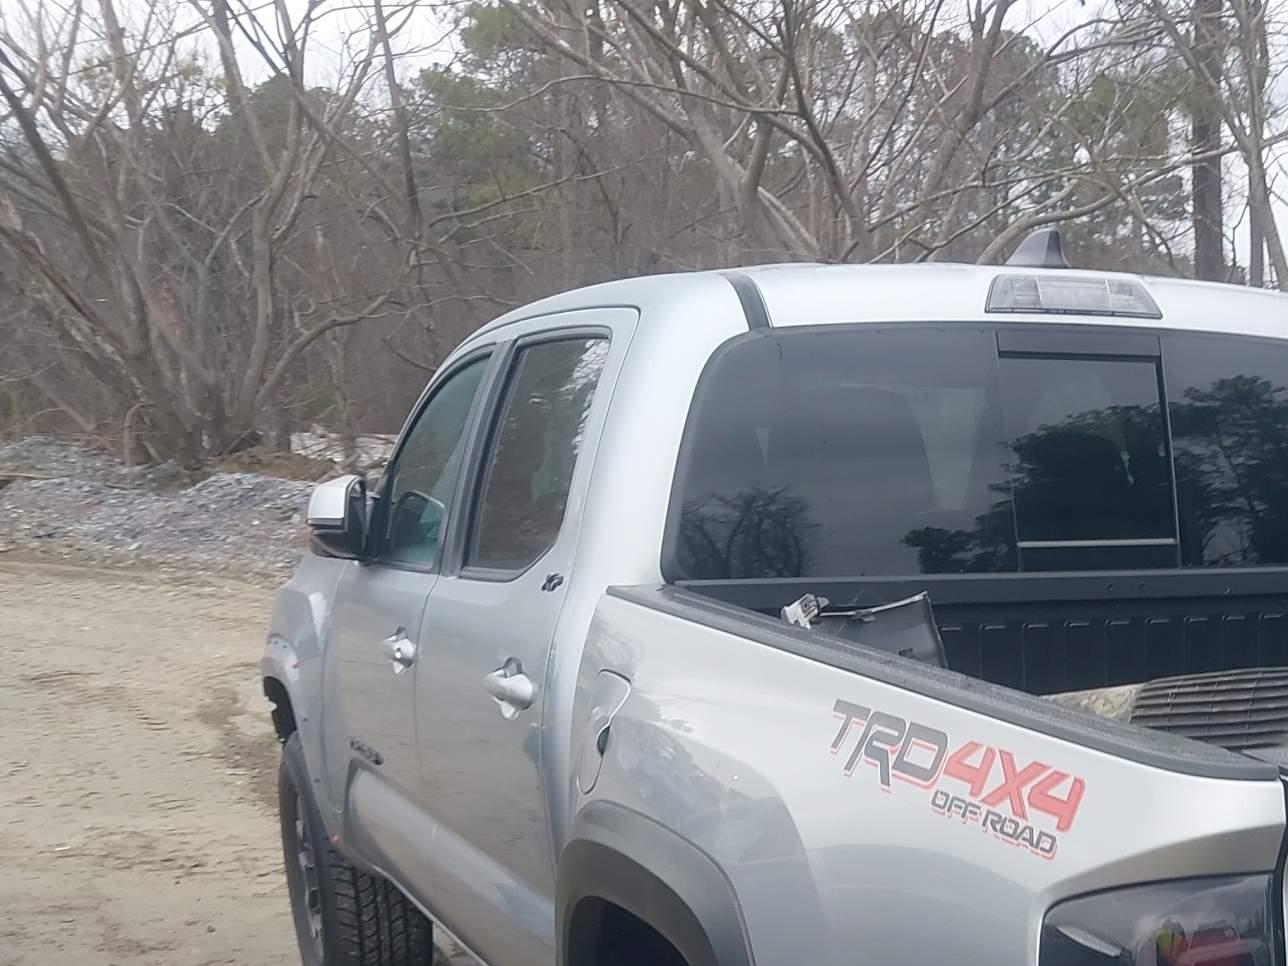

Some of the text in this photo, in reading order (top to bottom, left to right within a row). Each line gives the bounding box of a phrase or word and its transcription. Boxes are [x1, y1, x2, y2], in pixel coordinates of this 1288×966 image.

[830, 699, 949, 794] TRD
[931, 790, 1057, 858] OFF ROAD
